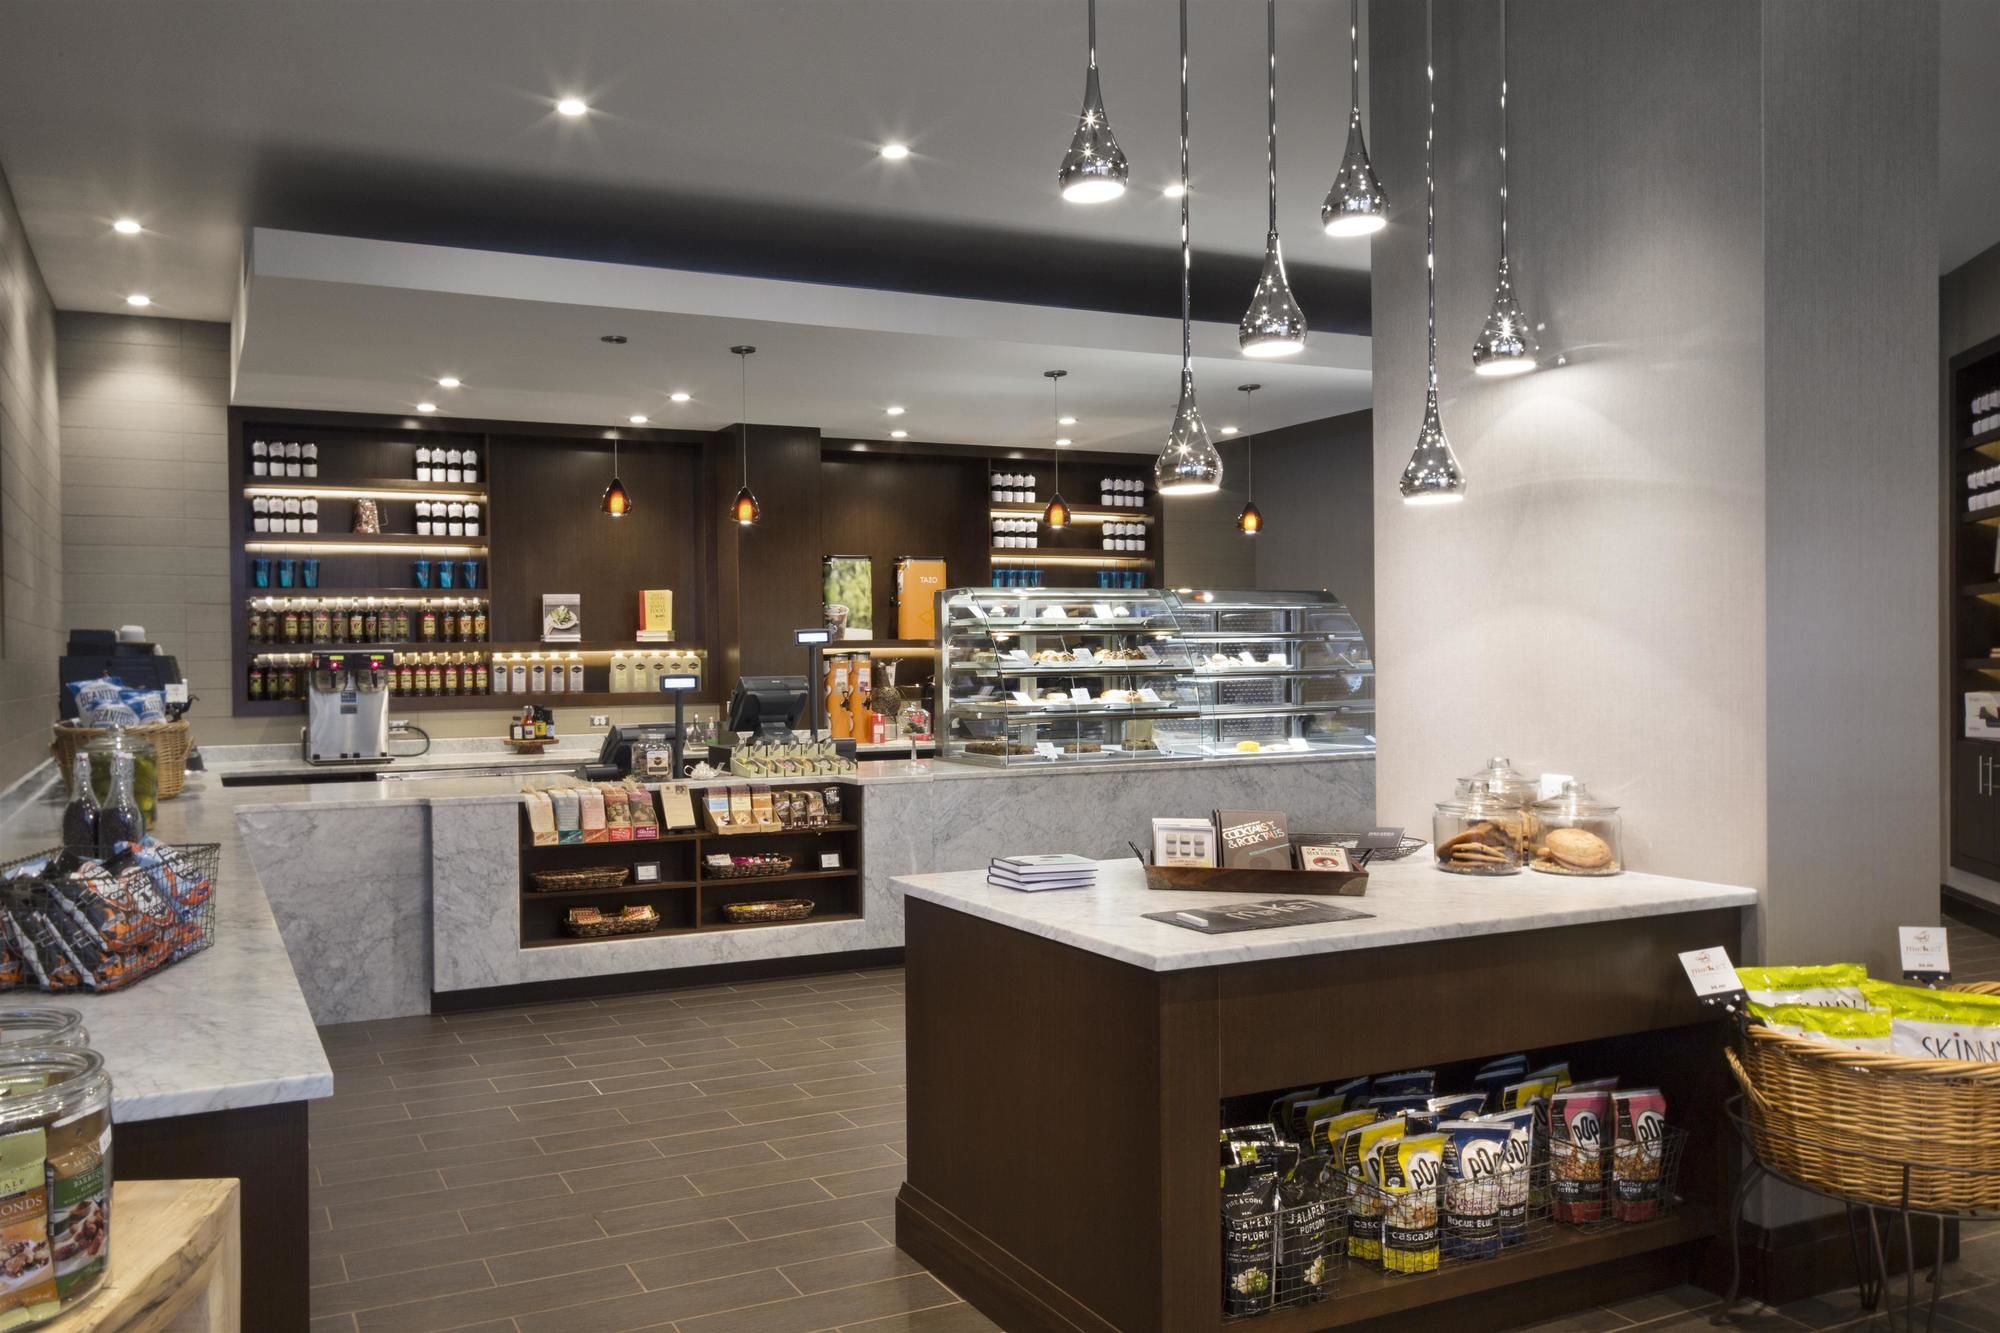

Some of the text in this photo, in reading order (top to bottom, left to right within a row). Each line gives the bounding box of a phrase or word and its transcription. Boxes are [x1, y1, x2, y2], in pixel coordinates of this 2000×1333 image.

[920, 576, 938, 584] TAZO
[1229, 1230, 1270, 1242] POPCORN
[1391, 1230, 1434, 1242] cascade
